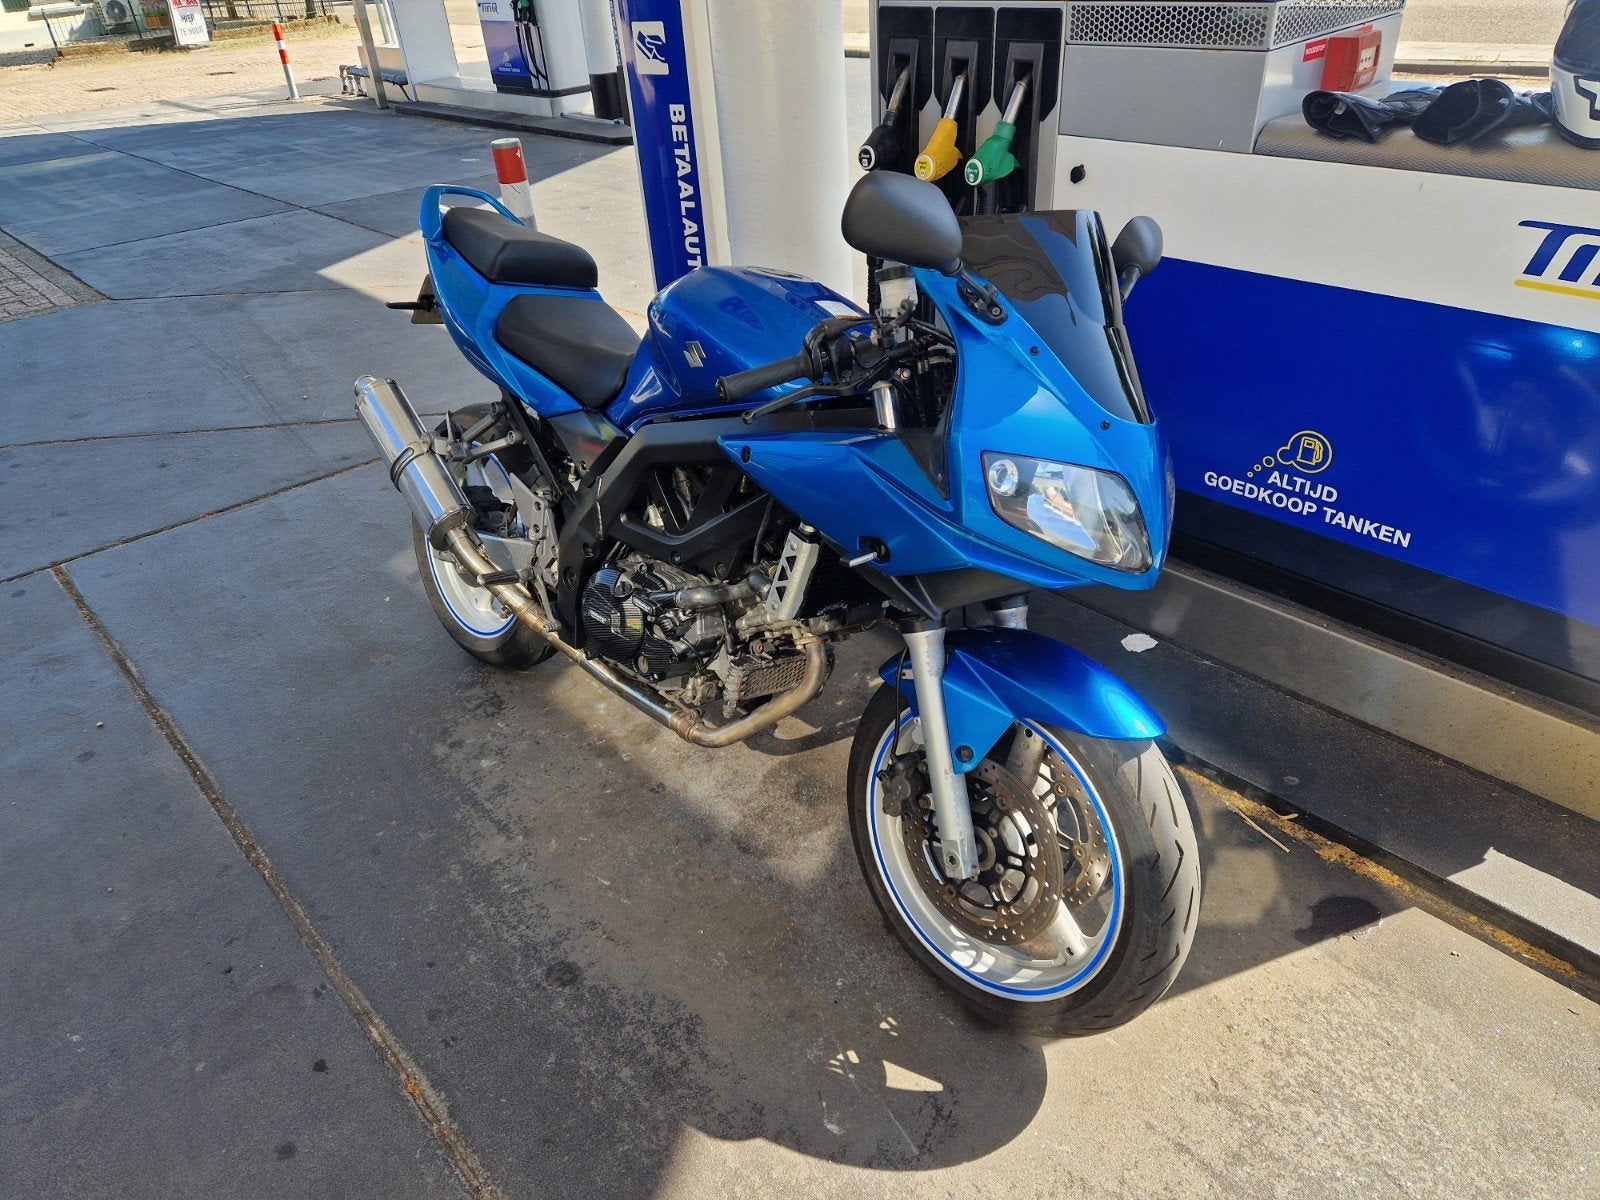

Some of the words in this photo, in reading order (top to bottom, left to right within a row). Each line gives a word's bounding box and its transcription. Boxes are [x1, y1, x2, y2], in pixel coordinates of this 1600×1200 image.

[1204, 471, 1317, 516] GOEDKOOP
[1322, 507, 1411, 548] TANKEN
[1267, 471, 1338, 503] ALTIJD
